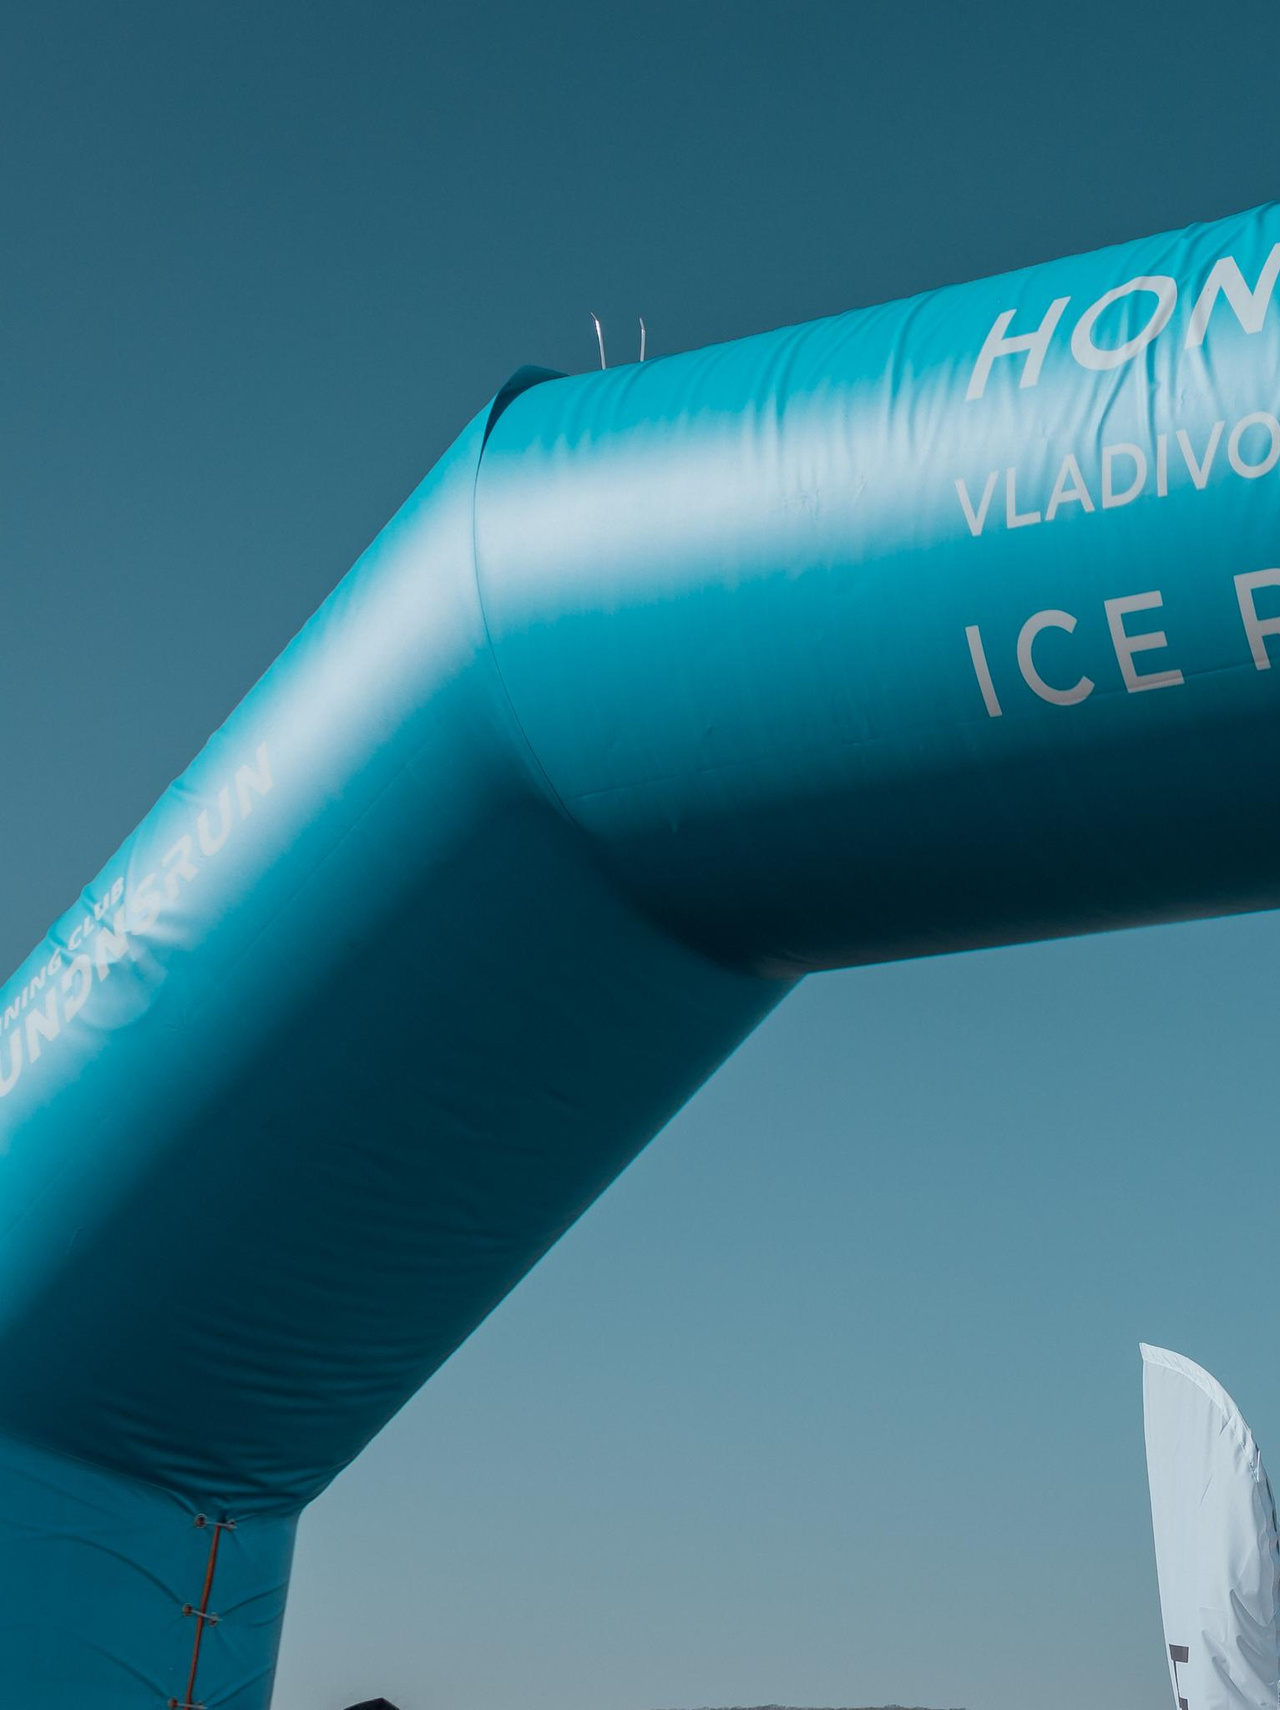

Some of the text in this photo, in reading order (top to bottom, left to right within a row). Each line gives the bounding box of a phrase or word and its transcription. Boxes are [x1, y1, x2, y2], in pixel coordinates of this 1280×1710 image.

[965, 590, 1185, 717] ICE
[0, 876, 124, 1034] NING CLUB
